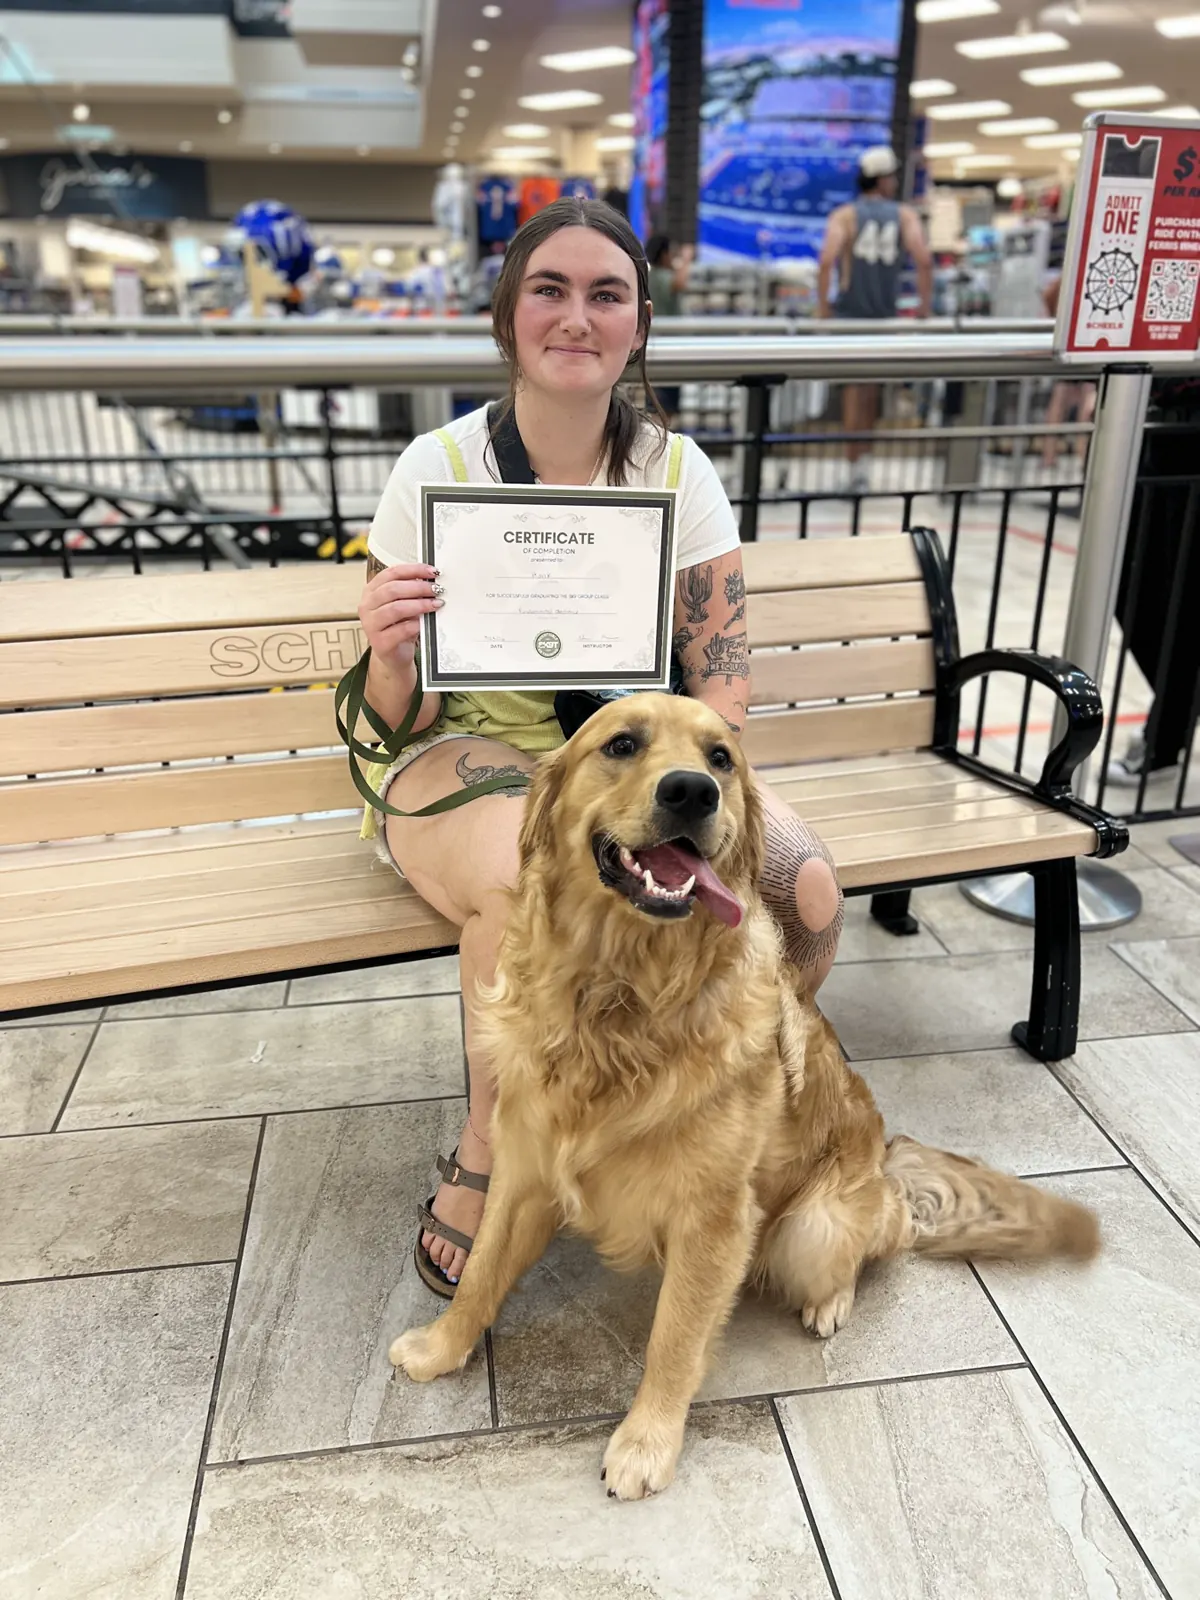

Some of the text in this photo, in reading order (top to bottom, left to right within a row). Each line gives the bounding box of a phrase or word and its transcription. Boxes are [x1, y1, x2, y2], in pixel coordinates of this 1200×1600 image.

[1105, 195, 1142, 209] ADMIT
[1103, 210, 1140, 234] ONE
[853, 219, 899, 265] 44
[503, 531, 595, 545] CERTIFICATE
[708, 662, 748, 673] LIQUO
